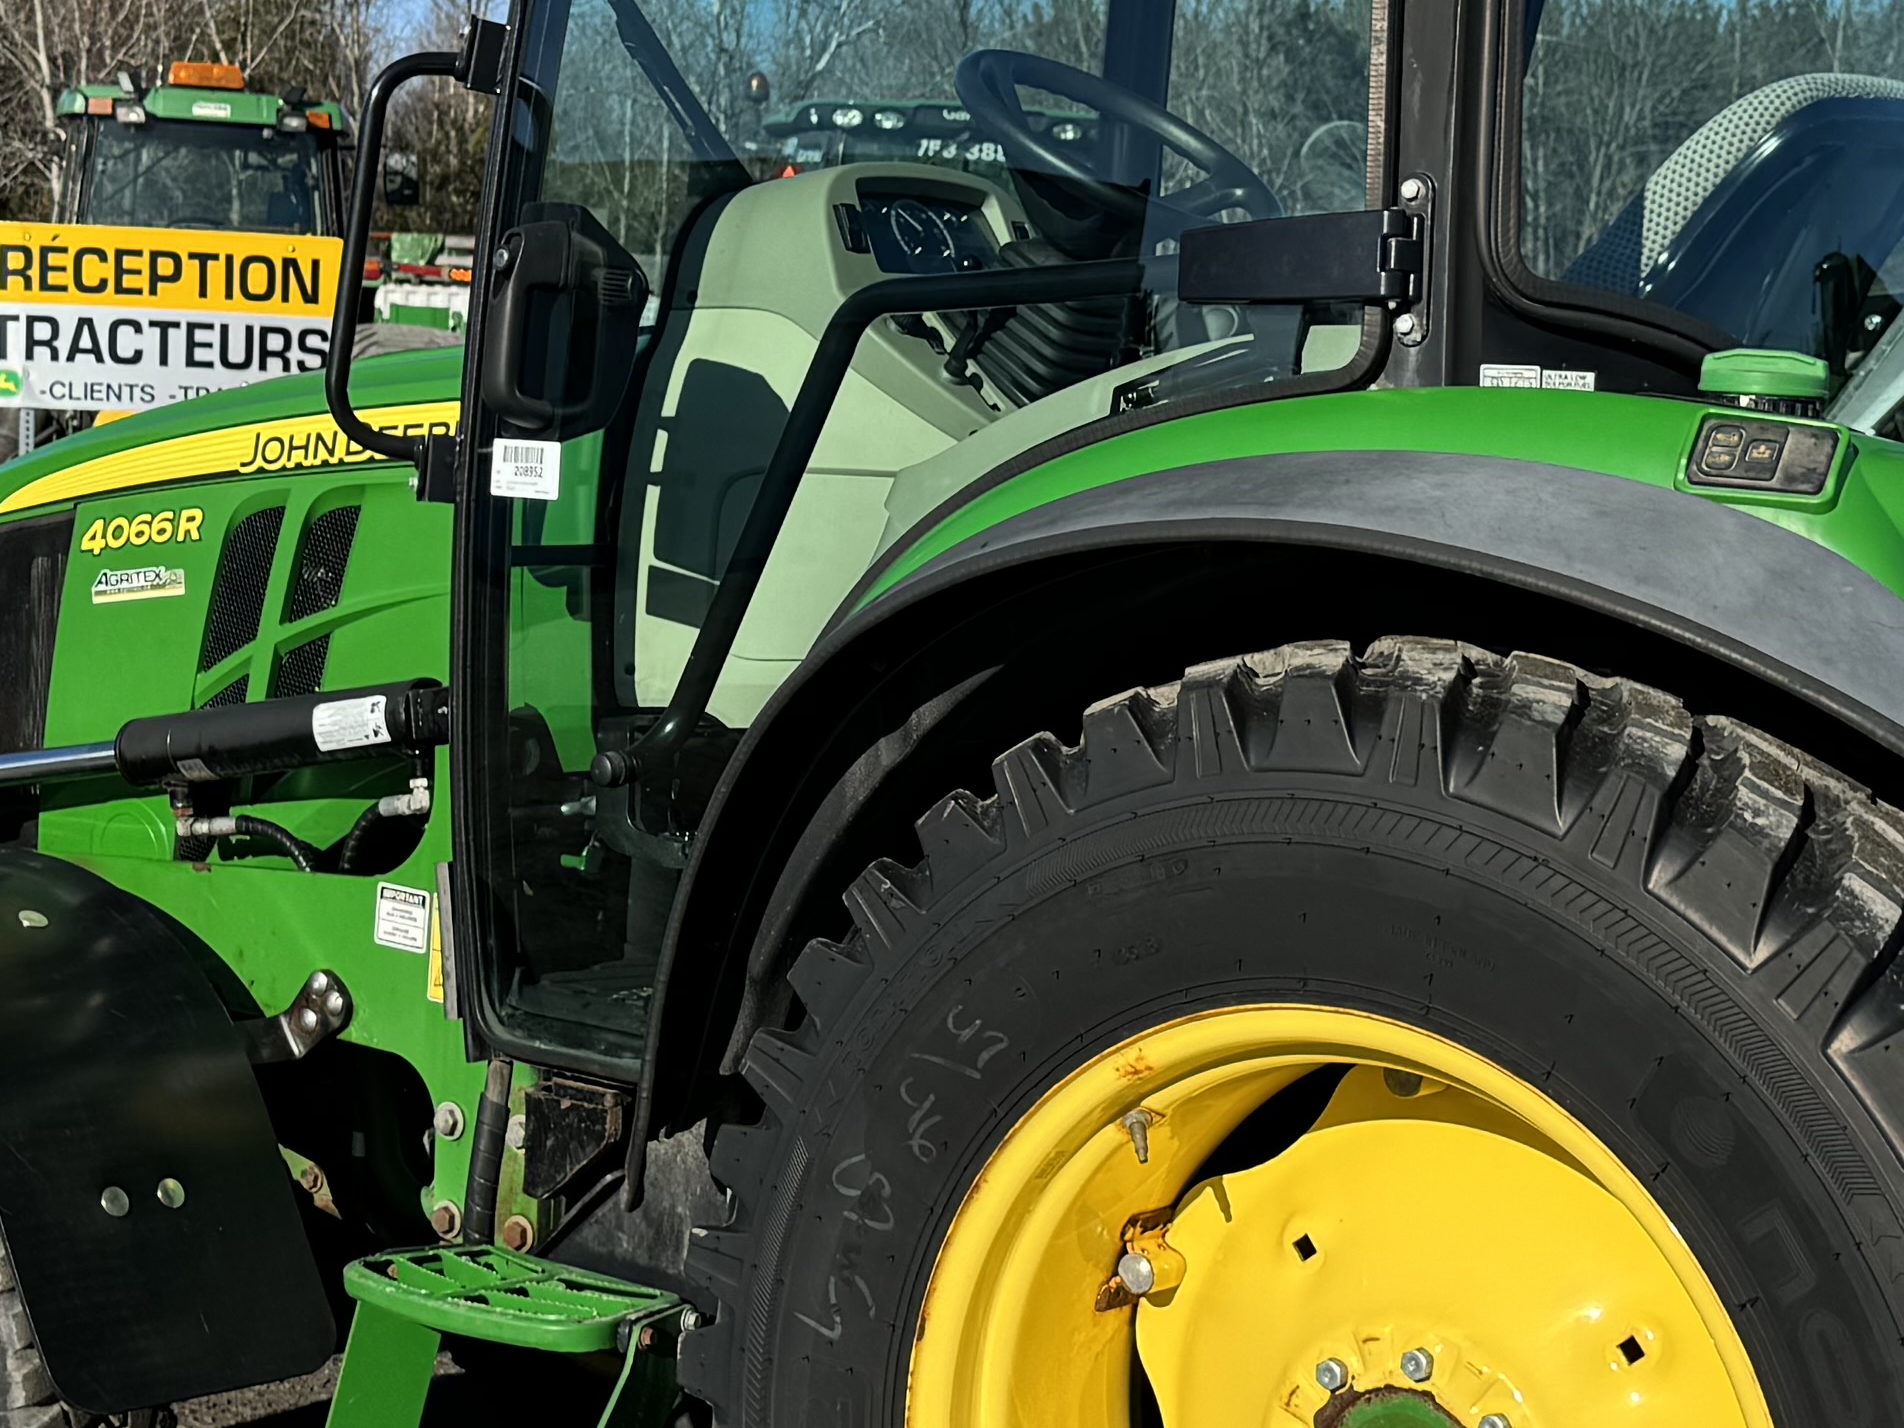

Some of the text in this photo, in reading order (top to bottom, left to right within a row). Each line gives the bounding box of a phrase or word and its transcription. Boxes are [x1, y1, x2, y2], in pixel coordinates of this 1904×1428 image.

[239, 431, 338, 469] JOHN
[80, 507, 204, 557] 4066R
[95, 568, 164, 588] AGRITEX
